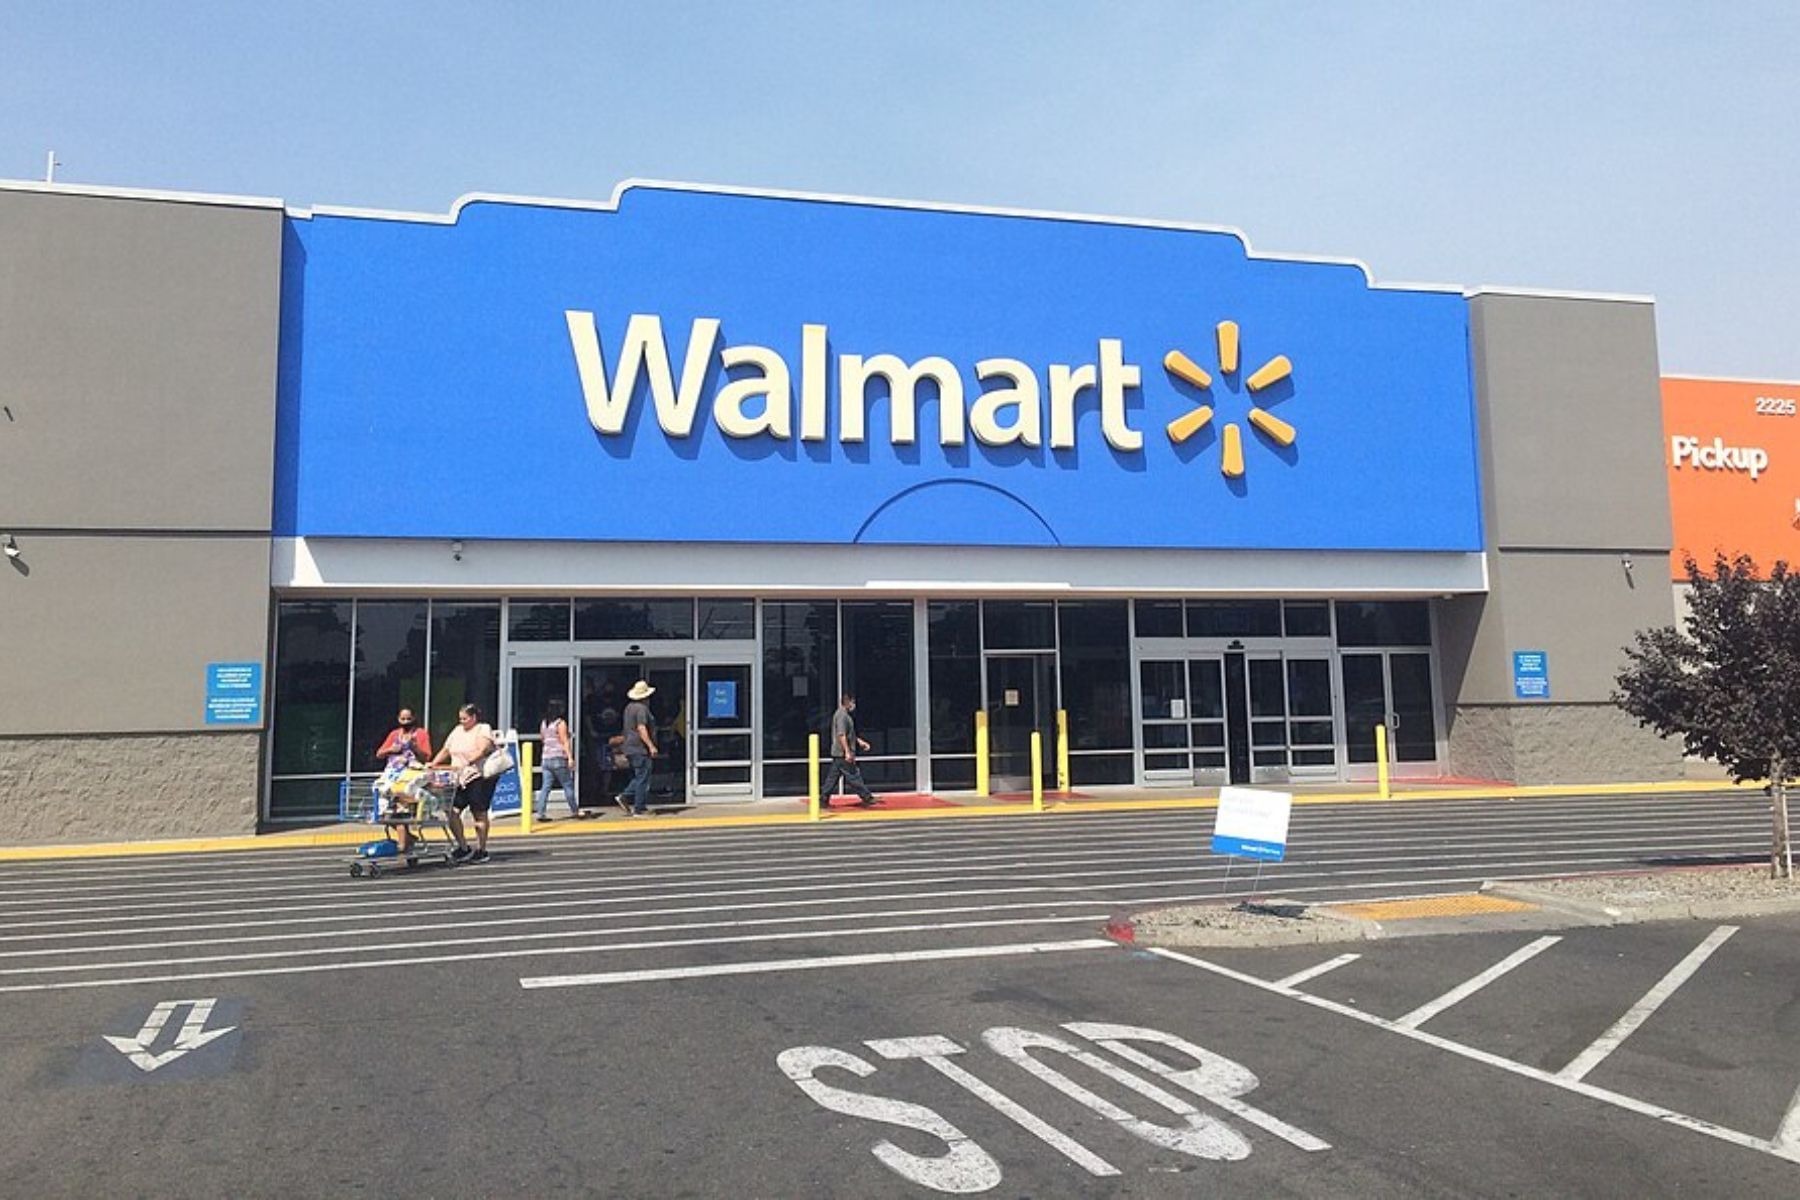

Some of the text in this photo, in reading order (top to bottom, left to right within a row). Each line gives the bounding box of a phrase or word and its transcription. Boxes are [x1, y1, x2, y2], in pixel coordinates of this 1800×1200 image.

[565, 310, 1143, 452] Walmart
[1755, 397, 1796, 414] 2225
[1671, 435, 1768, 479] Pickup
[776, 1022, 1332, 1193] STOP
